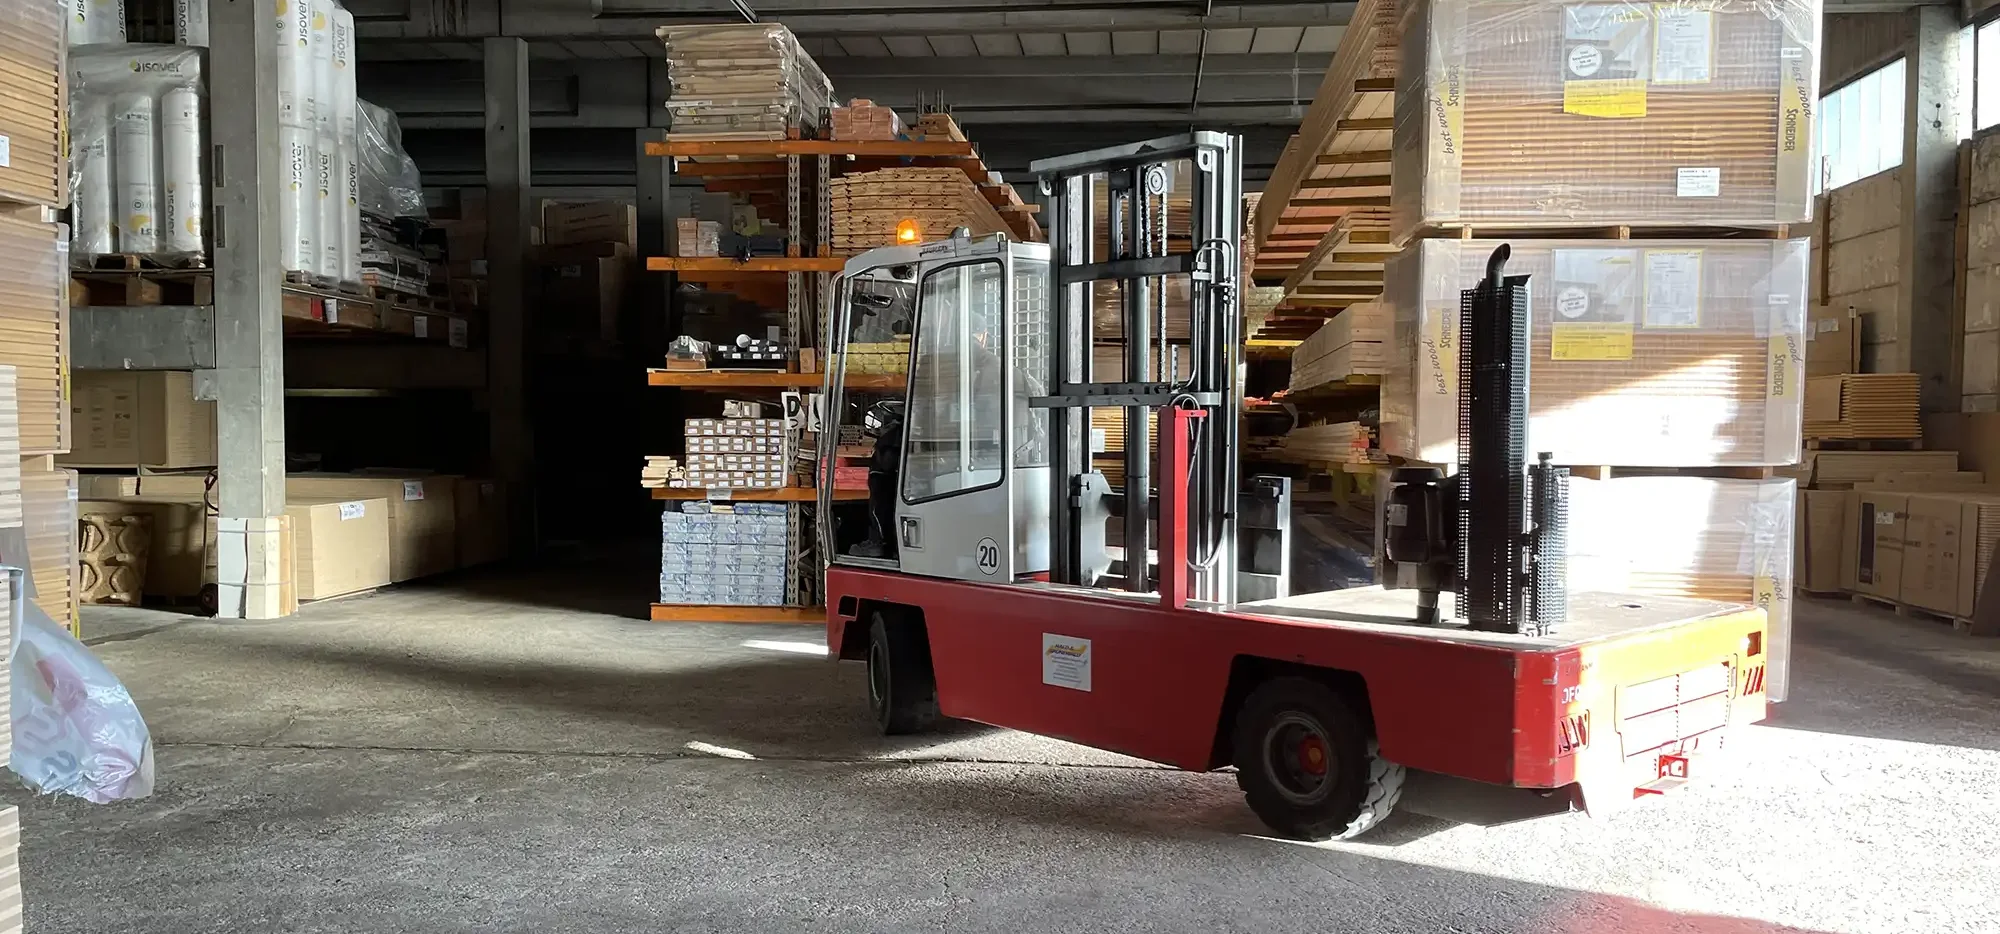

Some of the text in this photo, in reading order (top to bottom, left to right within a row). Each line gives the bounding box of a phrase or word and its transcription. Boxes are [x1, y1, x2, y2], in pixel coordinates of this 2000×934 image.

[337, 23, 347, 60] isover
[142, 62, 181, 73] isover
[1447, 64, 1460, 107] SCHNEIDER
[1429, 97, 1455, 154] best wood
[1784, 108, 1799, 152] SCHNEIDER
[319, 152, 328, 189] isover
[349, 161, 357, 196] isover
[1422, 339, 1448, 395] best wood
[1773, 354, 1786, 396] SCHNEIDER
[980, 546, 997, 567] 20
